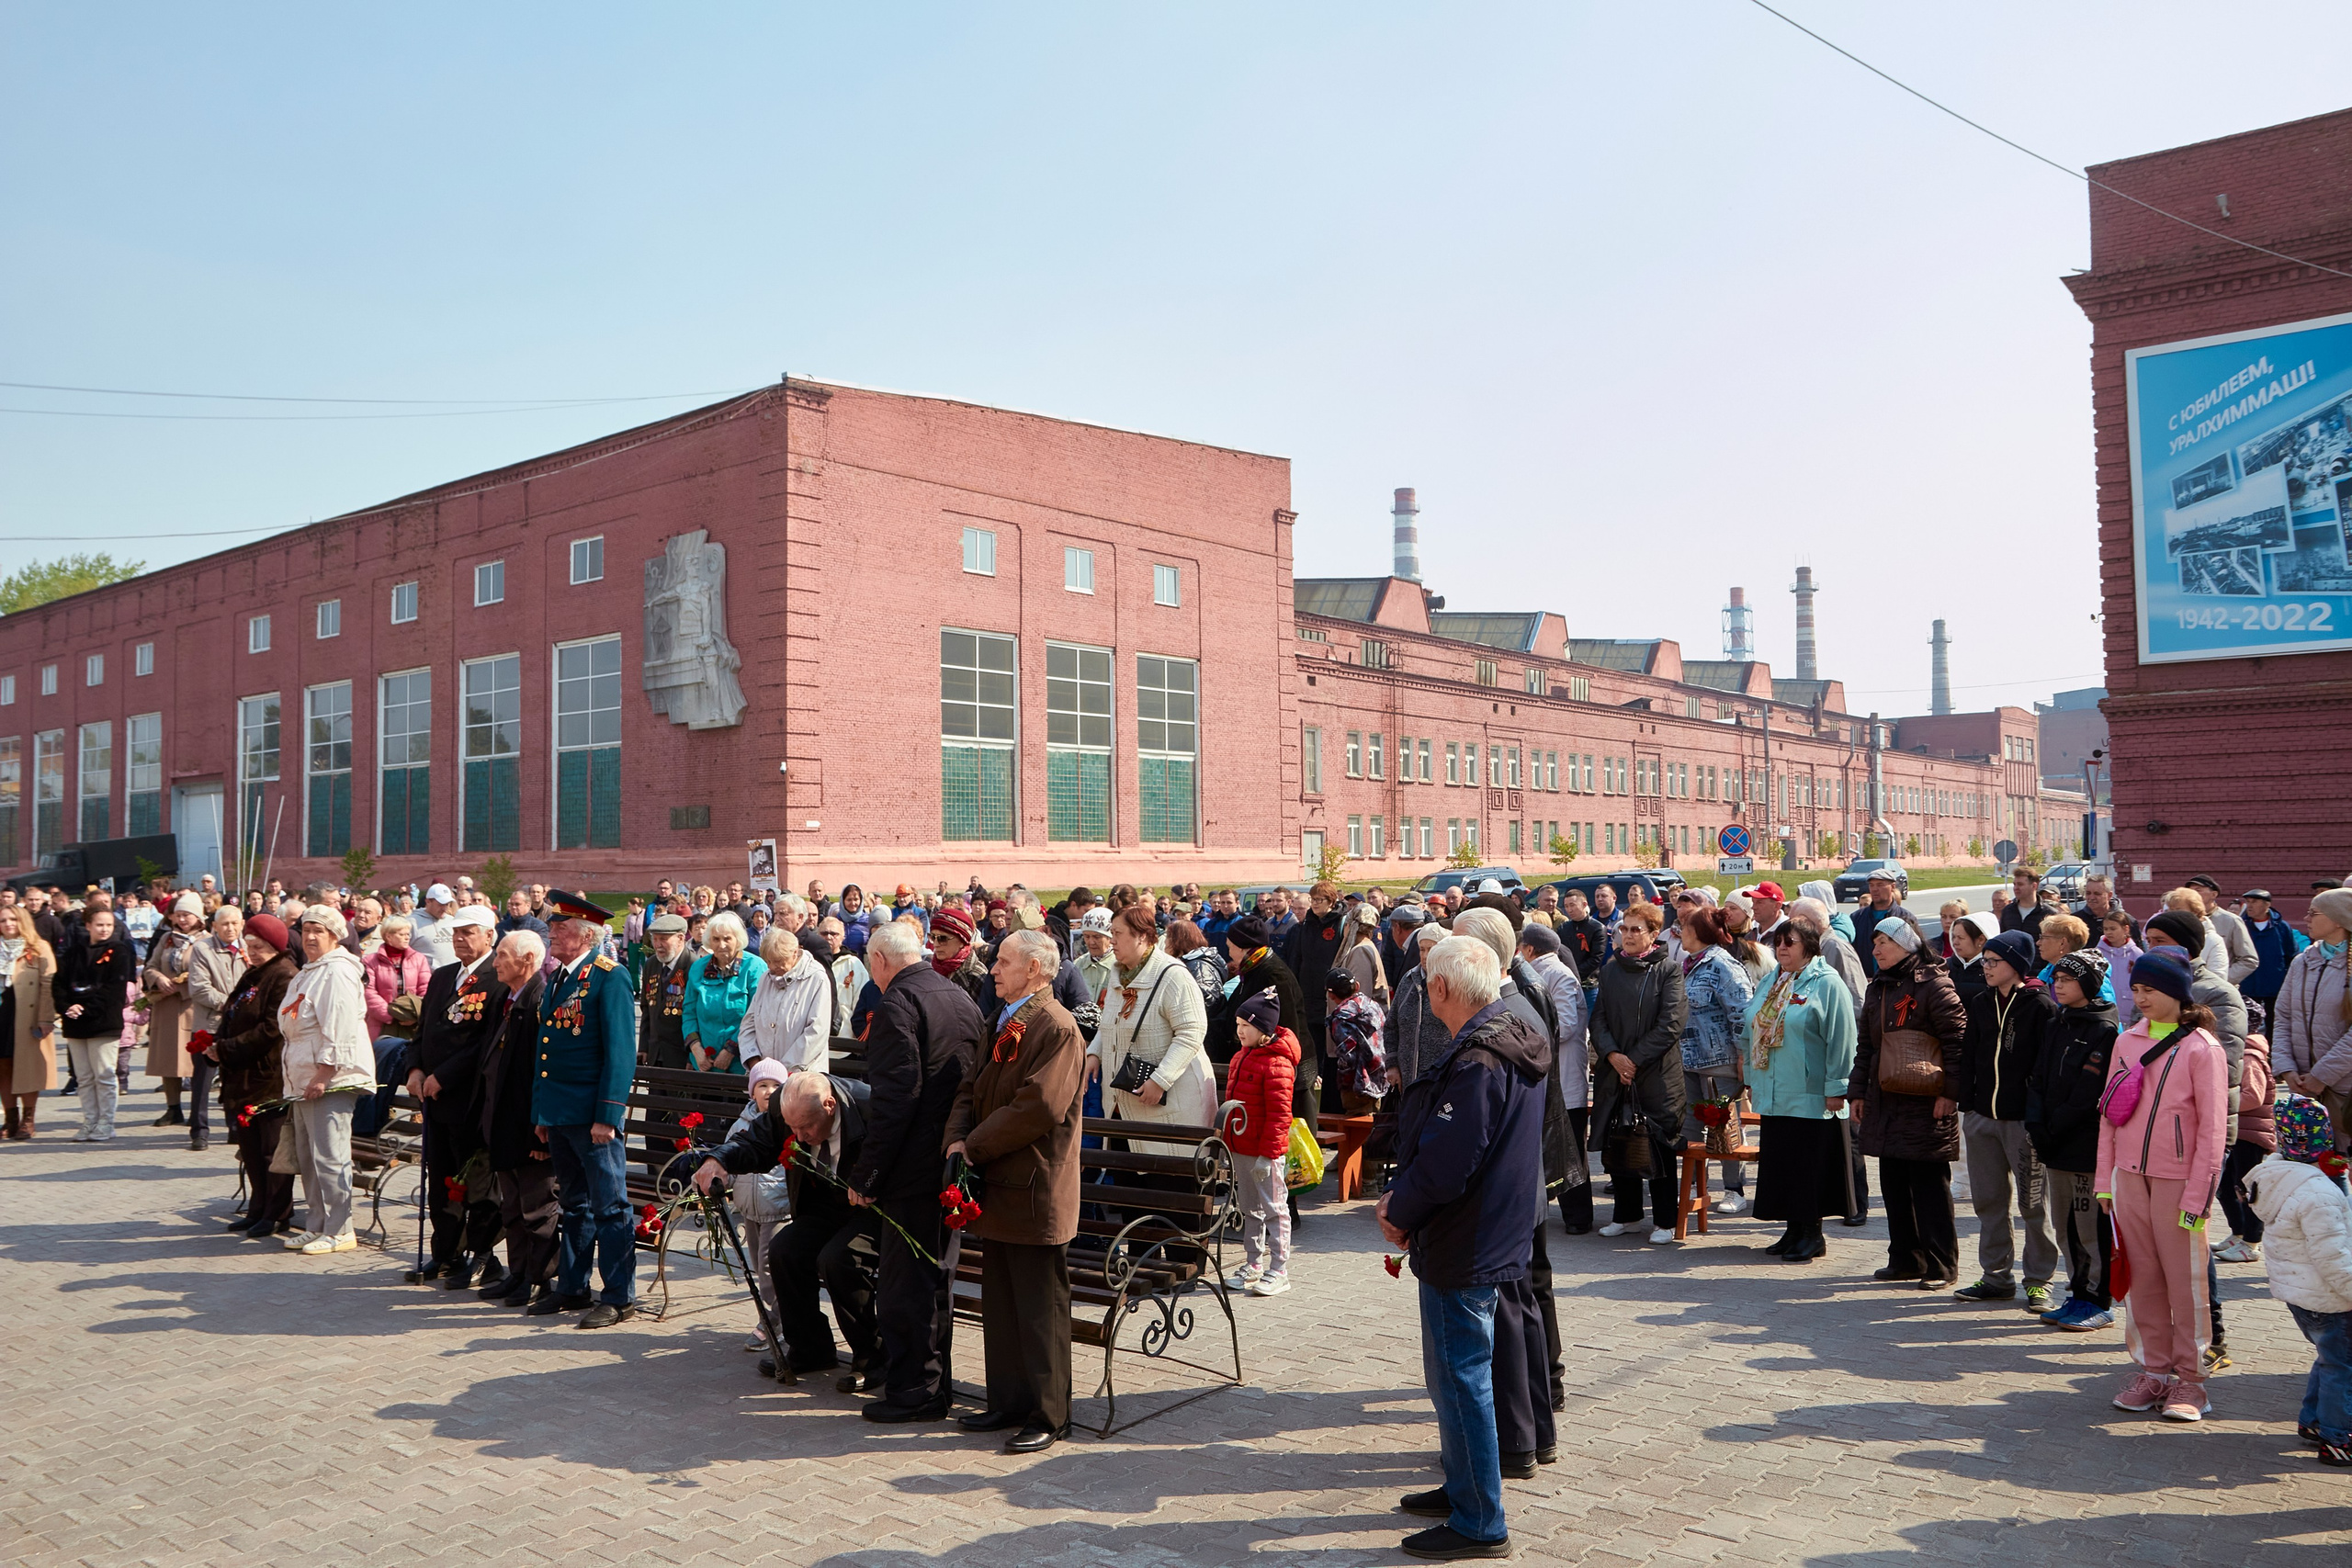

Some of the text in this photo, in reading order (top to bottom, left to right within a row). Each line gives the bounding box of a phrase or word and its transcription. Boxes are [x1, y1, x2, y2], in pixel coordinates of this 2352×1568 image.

[2168, 355, 2275, 431] С ЮБИЛЕЕМ,
[2168, 358, 2317, 457] УРАЛХИММАШ!
[2176, 602, 2335, 632] 1942-2022
[433, 935, 453, 944] adida
[2030, 1178, 2044, 1209] GOAL
[2075, 1197, 2090, 1213] 18
